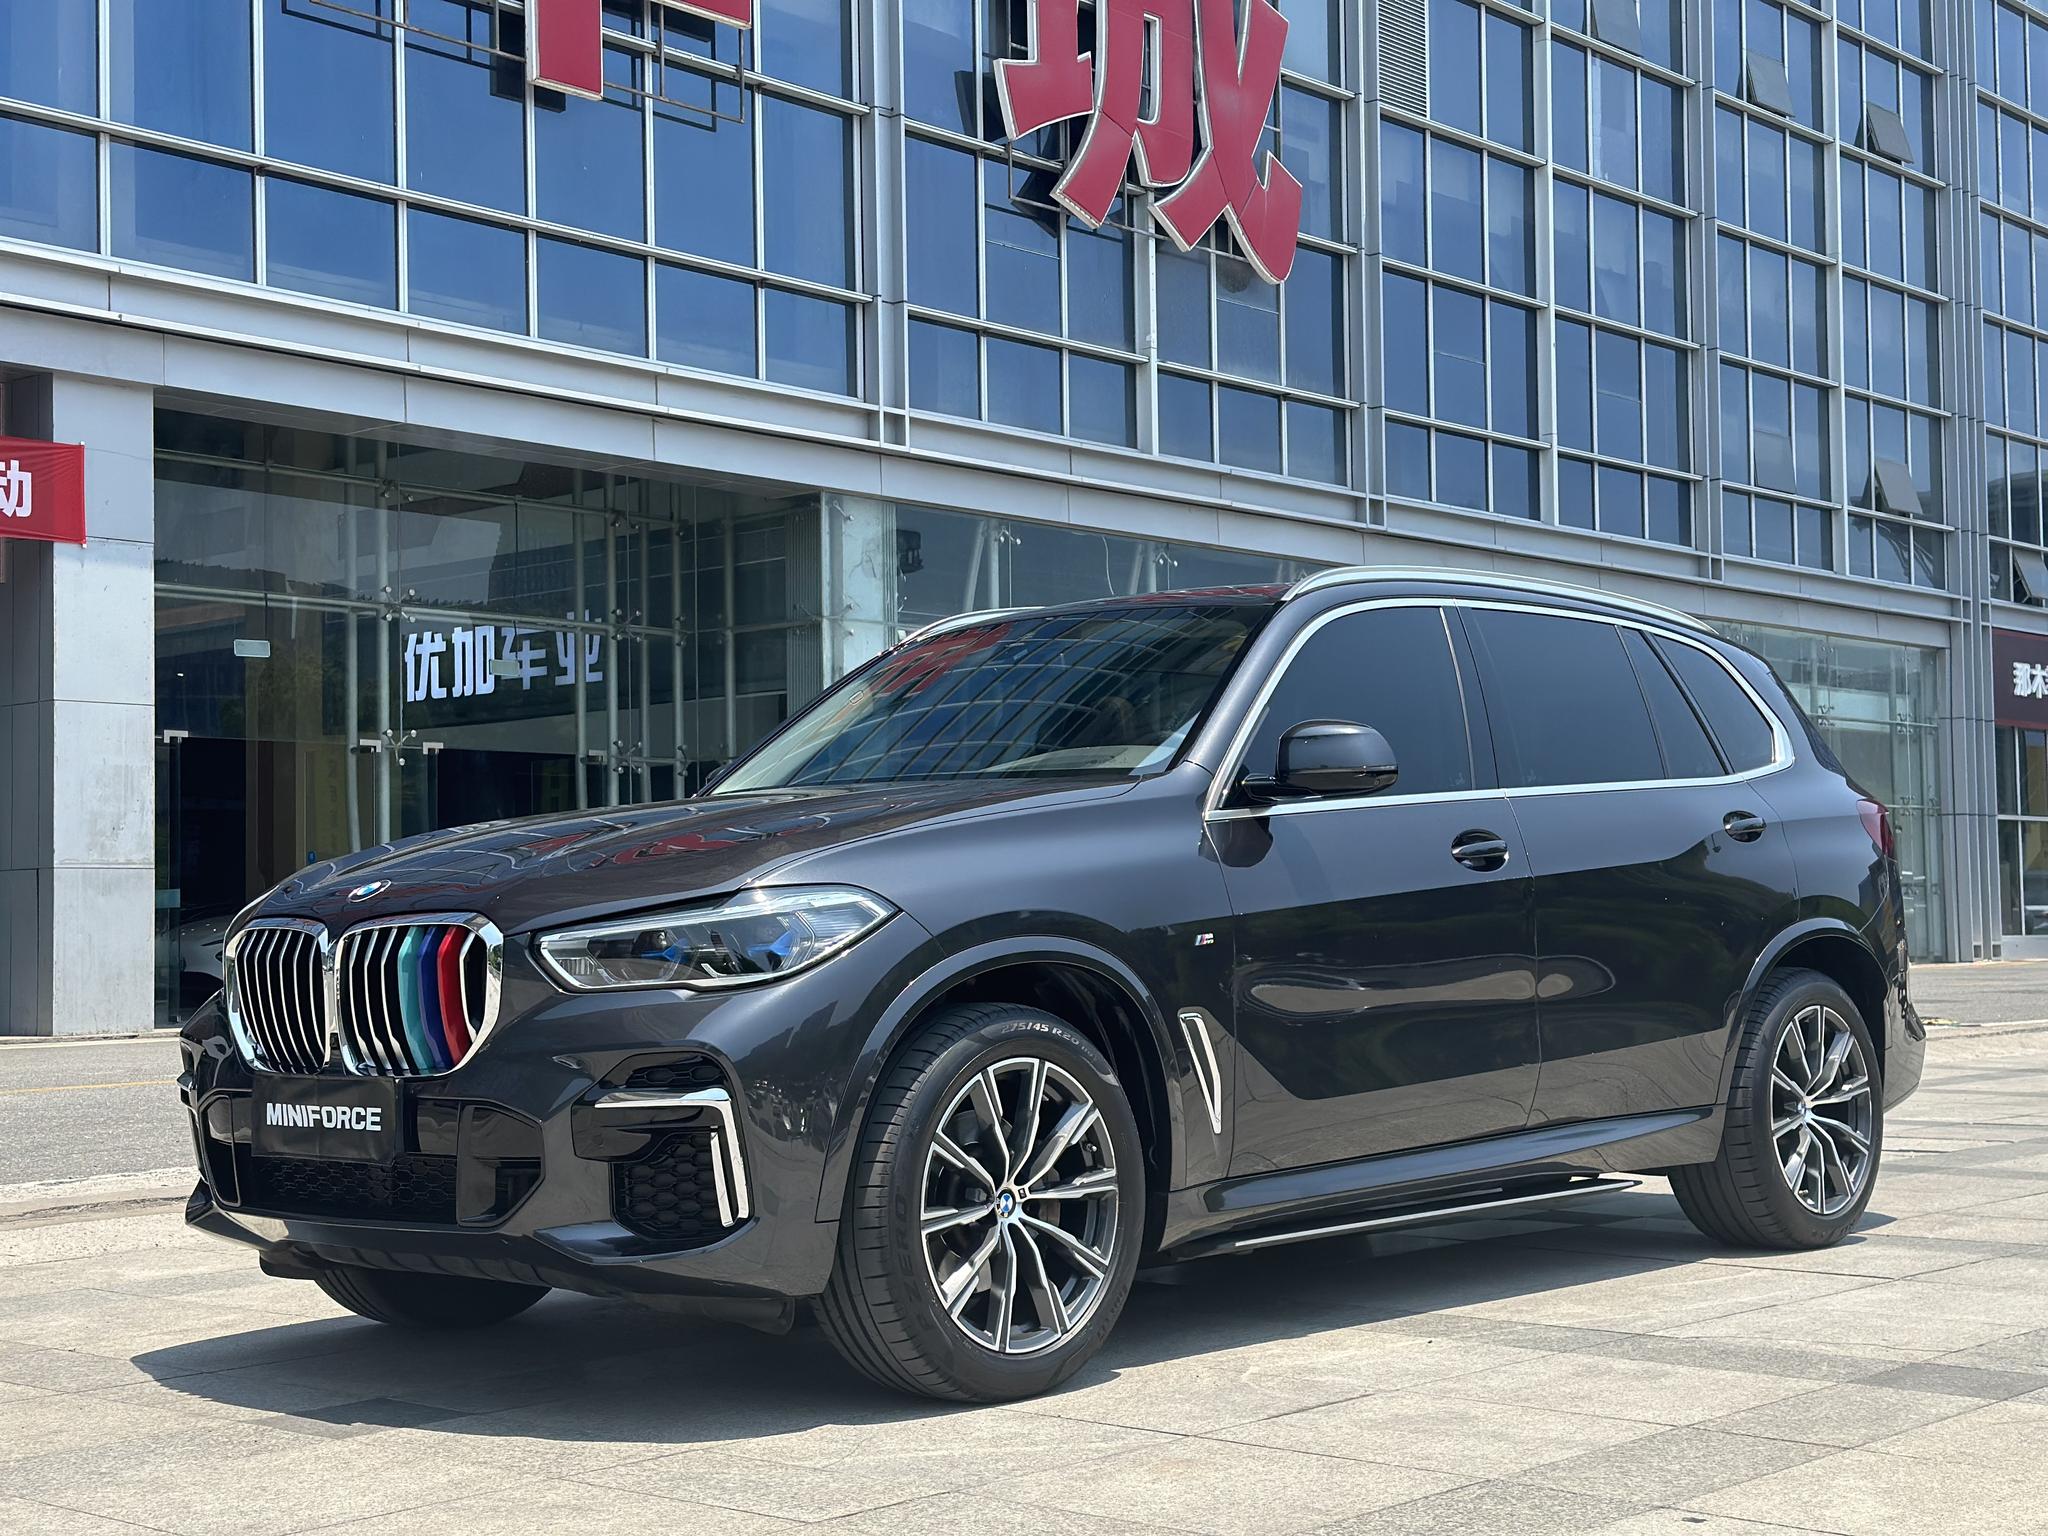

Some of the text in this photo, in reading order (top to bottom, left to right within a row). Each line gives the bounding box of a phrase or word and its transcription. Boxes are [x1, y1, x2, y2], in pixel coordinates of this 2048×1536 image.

[404, 608, 604, 703] 优加车业
[2012, 661, 2048, 699] 那木
[1001, 1021, 1081, 1046] 275/45 R20
[265, 1102, 383, 1132] MINIFORCE
